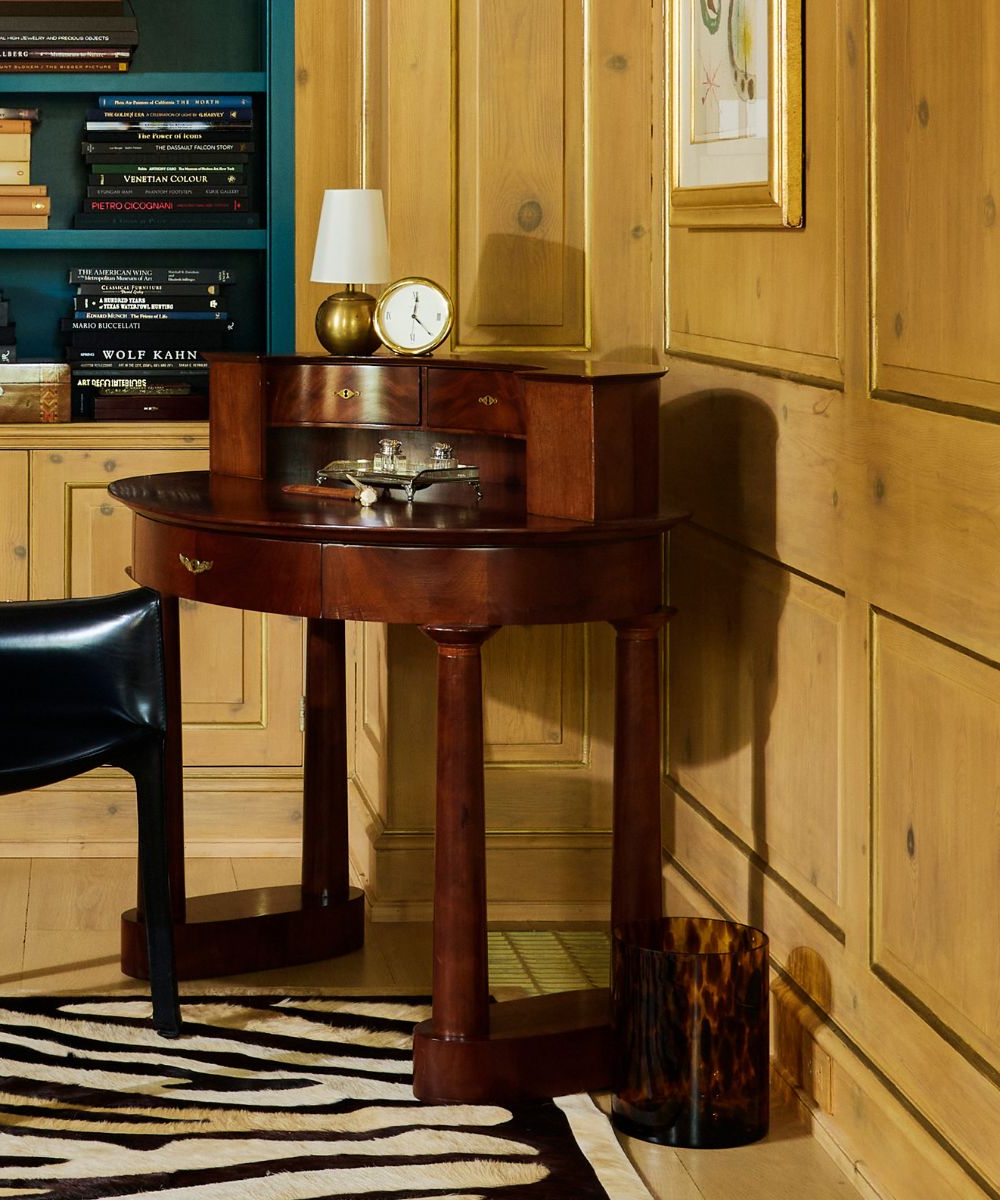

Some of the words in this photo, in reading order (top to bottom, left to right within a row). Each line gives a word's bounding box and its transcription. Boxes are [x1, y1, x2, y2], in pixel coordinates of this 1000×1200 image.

[124, 175, 167, 183] VENETIAN
[170, 175, 208, 183] COLOUR
[102, 350, 146, 359] WOLF
[153, 350, 197, 359] KAHN
